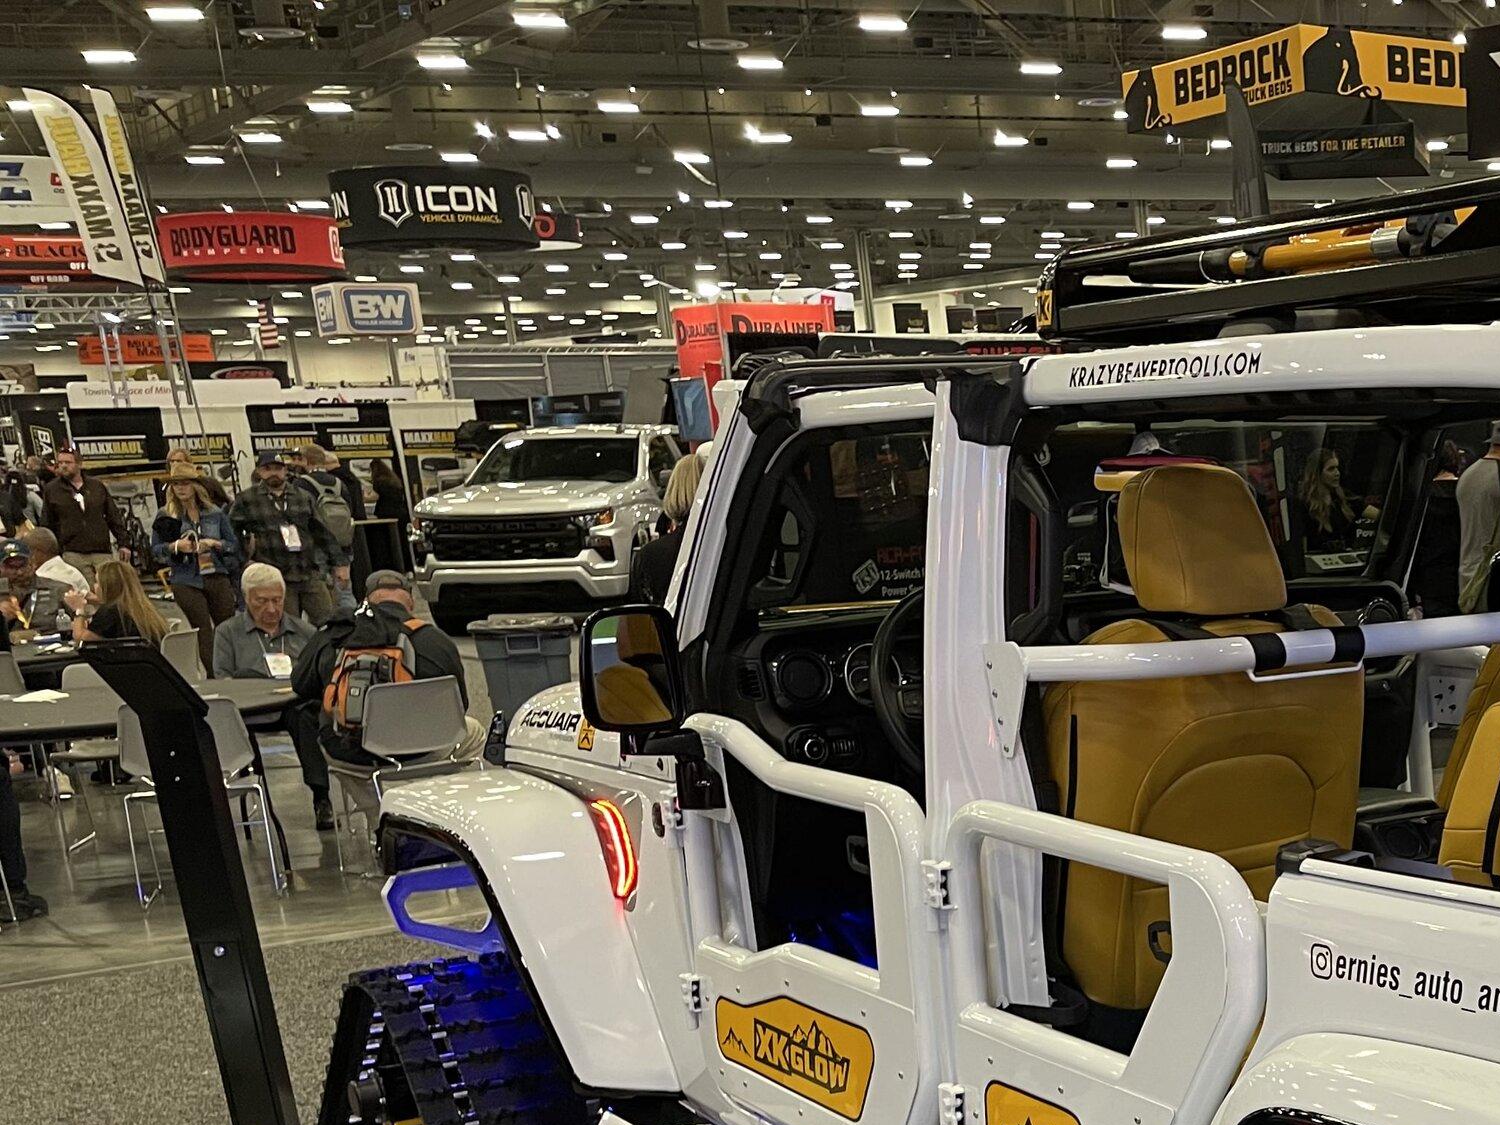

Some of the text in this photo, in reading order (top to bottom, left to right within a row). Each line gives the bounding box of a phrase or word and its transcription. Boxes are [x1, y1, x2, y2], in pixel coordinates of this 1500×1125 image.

[1174, 38, 1291, 106] BEDROCK
[1386, 45, 1466, 89] BED
[1268, 79, 1293, 99] BEDS
[1261, 135, 1406, 154] TRUCK BEDS FOR THE RETAILER
[414, 185, 498, 213] ICON
[419, 213, 457, 223] VEHICLE
[170, 224, 297, 257] BODYGUARD
[1069, 352, 1262, 388] KRAZYBEAVERTOOLS.COM
[83, 387, 111, 397] Towin
[520, 709, 581, 733] ACCUAIR
